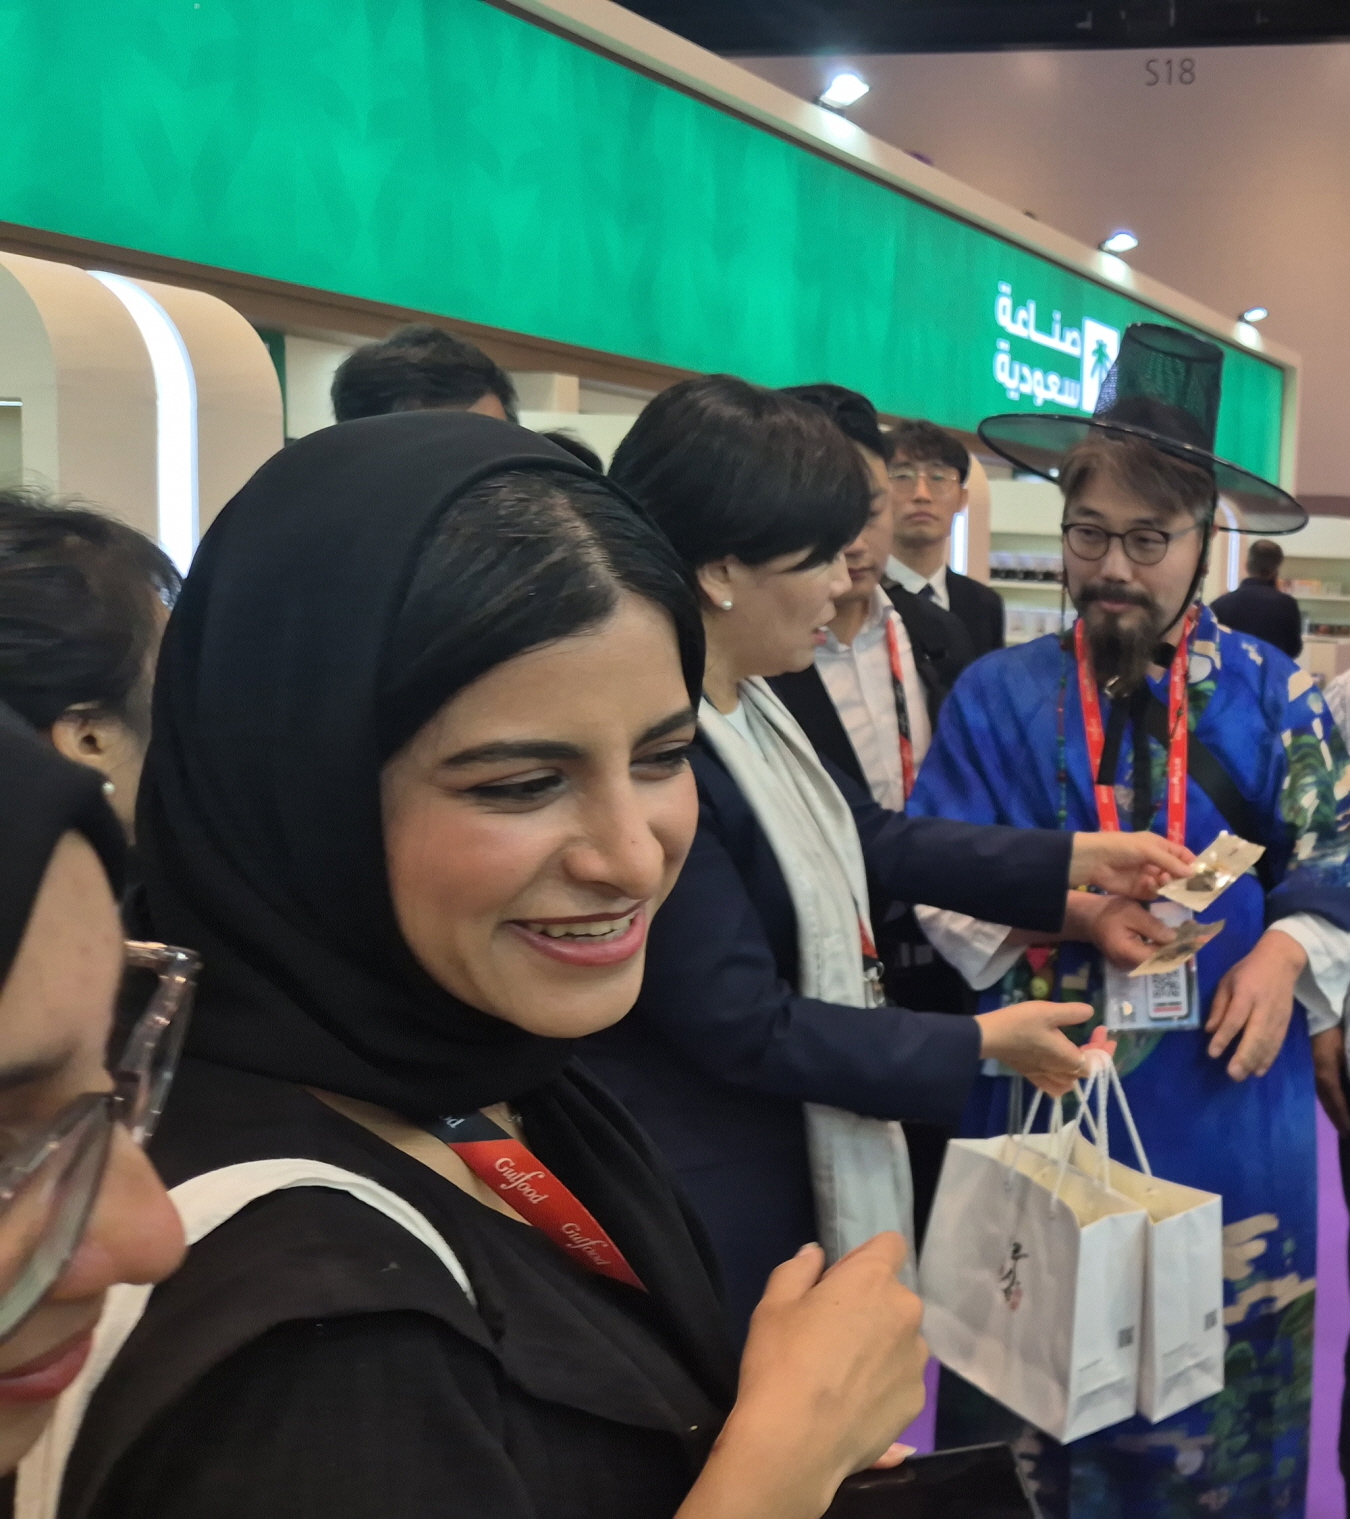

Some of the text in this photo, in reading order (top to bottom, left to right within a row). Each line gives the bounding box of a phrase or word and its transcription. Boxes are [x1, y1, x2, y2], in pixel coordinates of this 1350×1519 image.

[1145, 58, 1196, 87] S18
[994, 280, 1081, 359] صناعة
[992, 337, 1081, 409] سعودية
[494, 1156, 549, 1205] Gulfood
[561, 1222, 612, 1266] Gulfood
